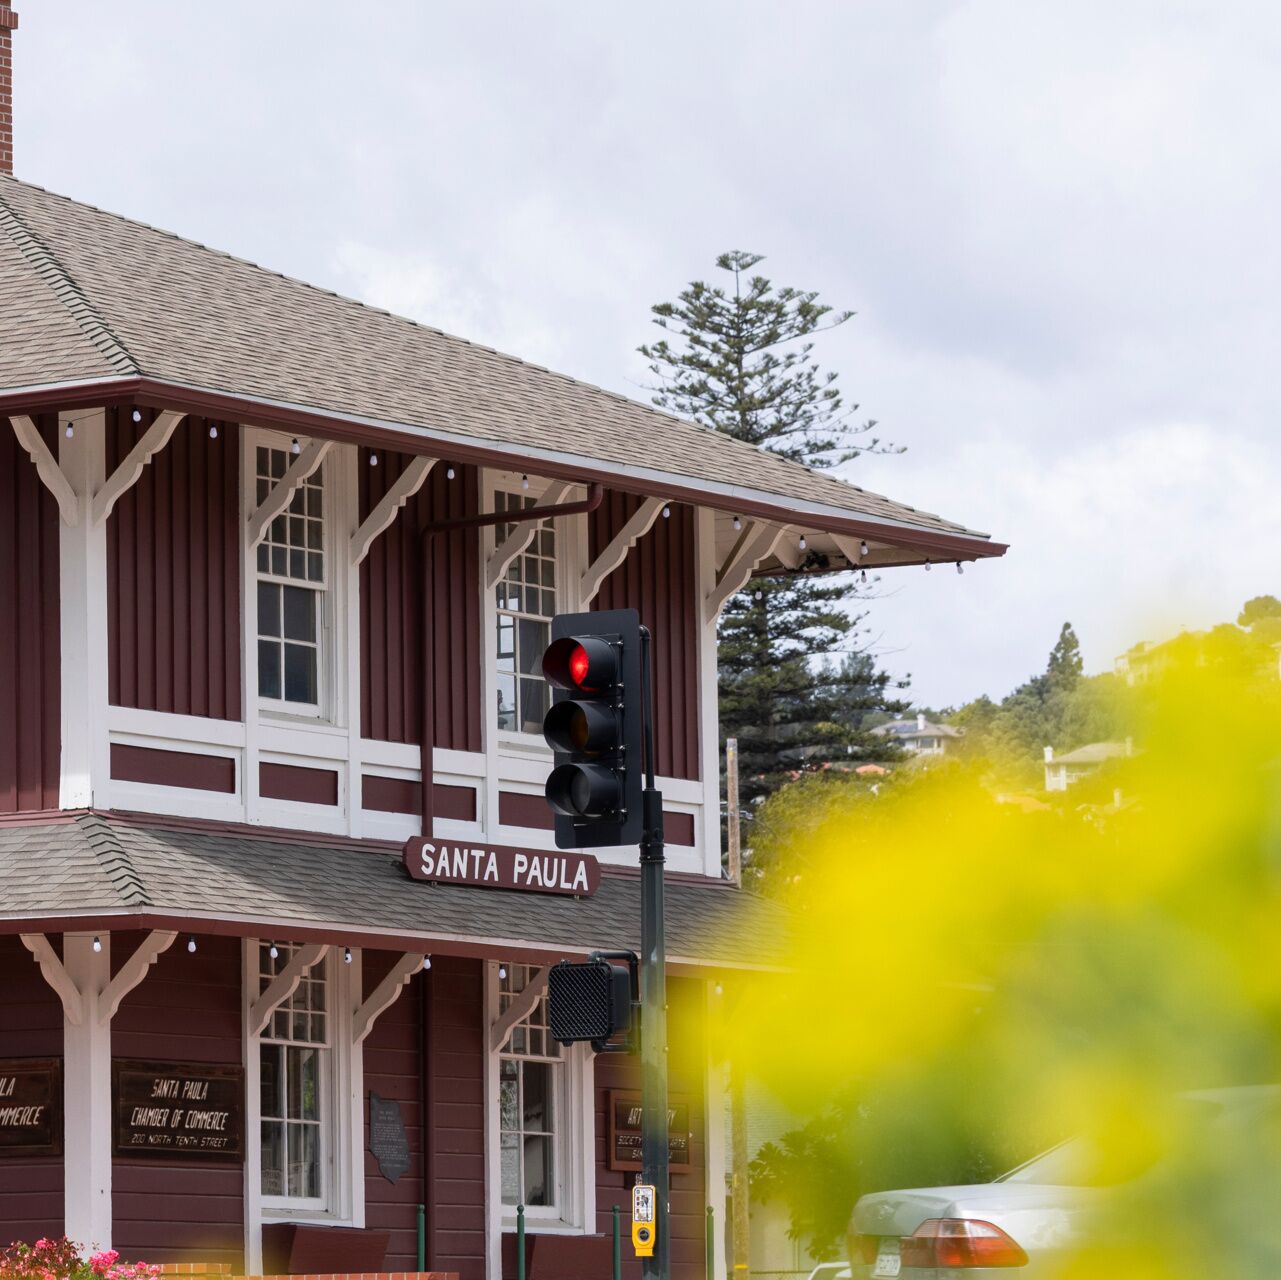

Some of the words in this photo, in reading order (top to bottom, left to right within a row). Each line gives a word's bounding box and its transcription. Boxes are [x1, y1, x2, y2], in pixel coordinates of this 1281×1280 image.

[421, 843, 499, 882] SANTA
[513, 853, 588, 891] PAULA
[151, 1079, 180, 1098] SANTA
[182, 1081, 209, 1100] PAULA
[130, 1107, 170, 1127] CHAMBER
[170, 1109, 184, 1128] OF
[185, 1110, 229, 1131] COMMERCE
[149, 1135, 171, 1144] NORTH
[176, 1135, 198, 1146] TENTH
[201, 1136, 229, 1147] STREET
